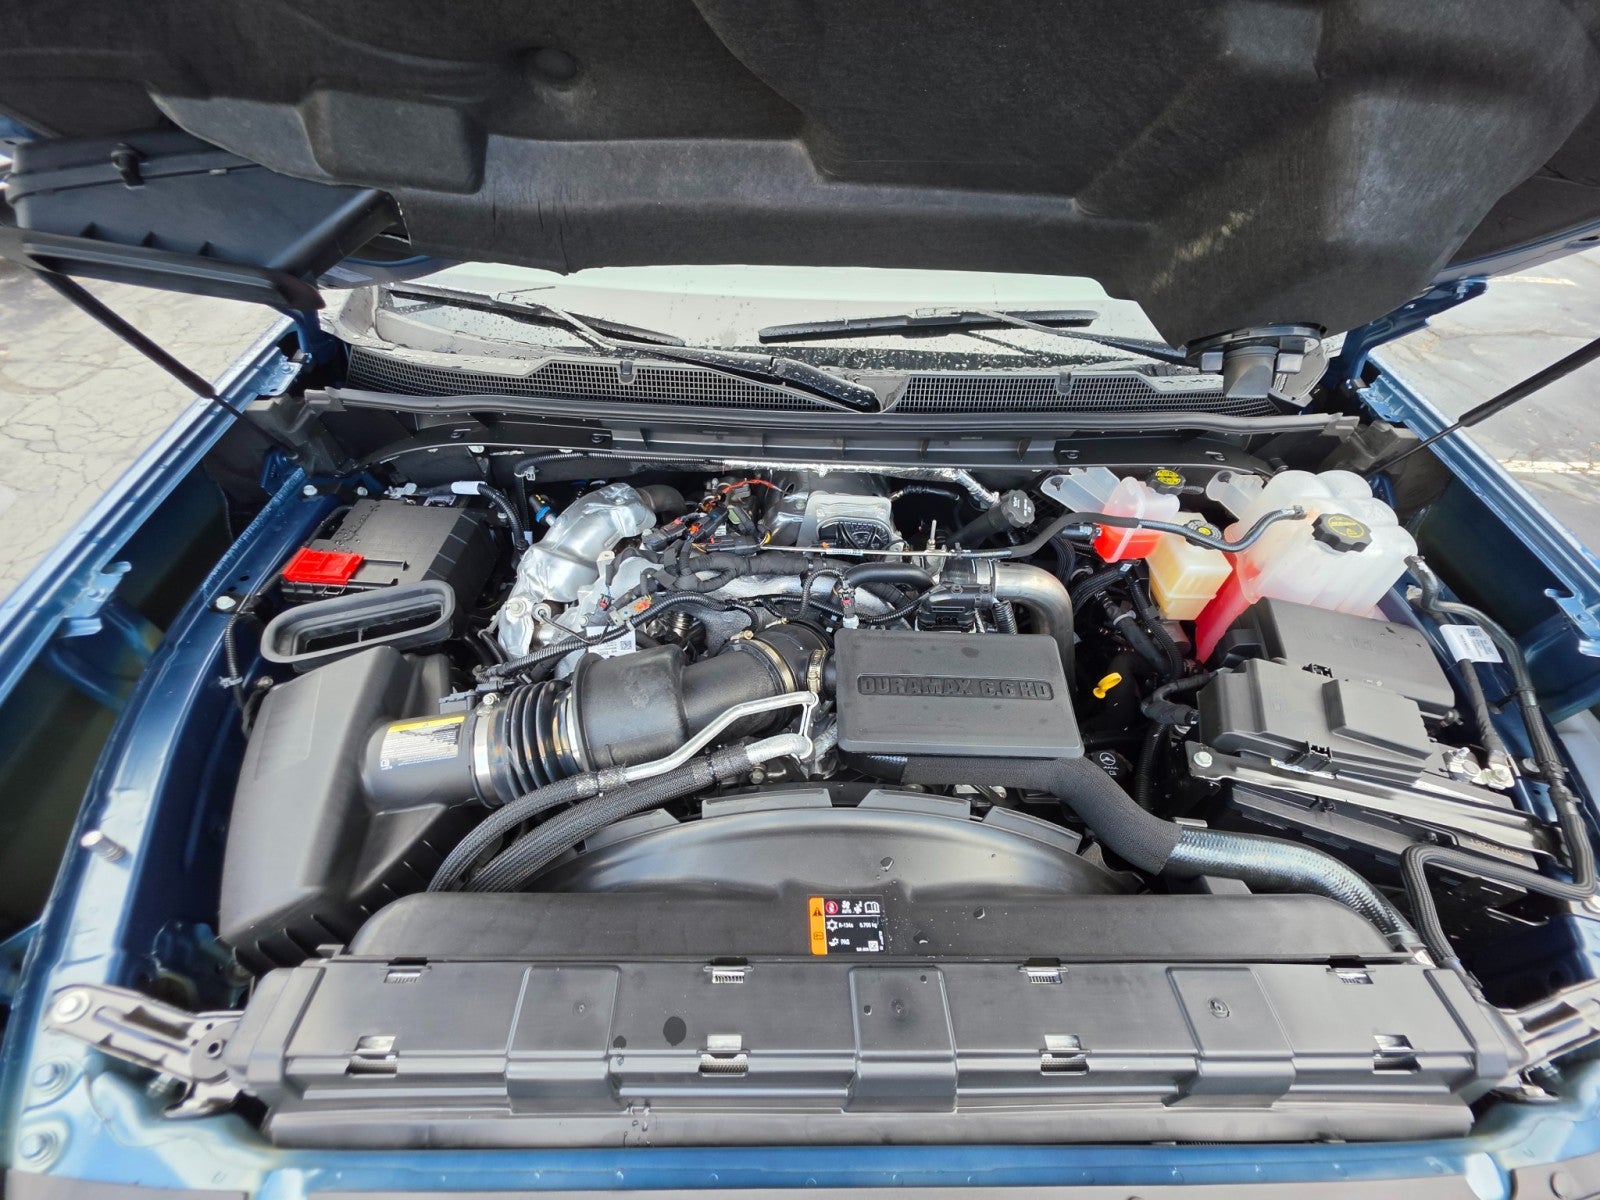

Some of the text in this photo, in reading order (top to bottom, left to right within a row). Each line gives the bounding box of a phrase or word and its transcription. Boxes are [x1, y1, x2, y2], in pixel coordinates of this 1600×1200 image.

[861, 677, 1051, 700] DURAMAX 6.6 HD
